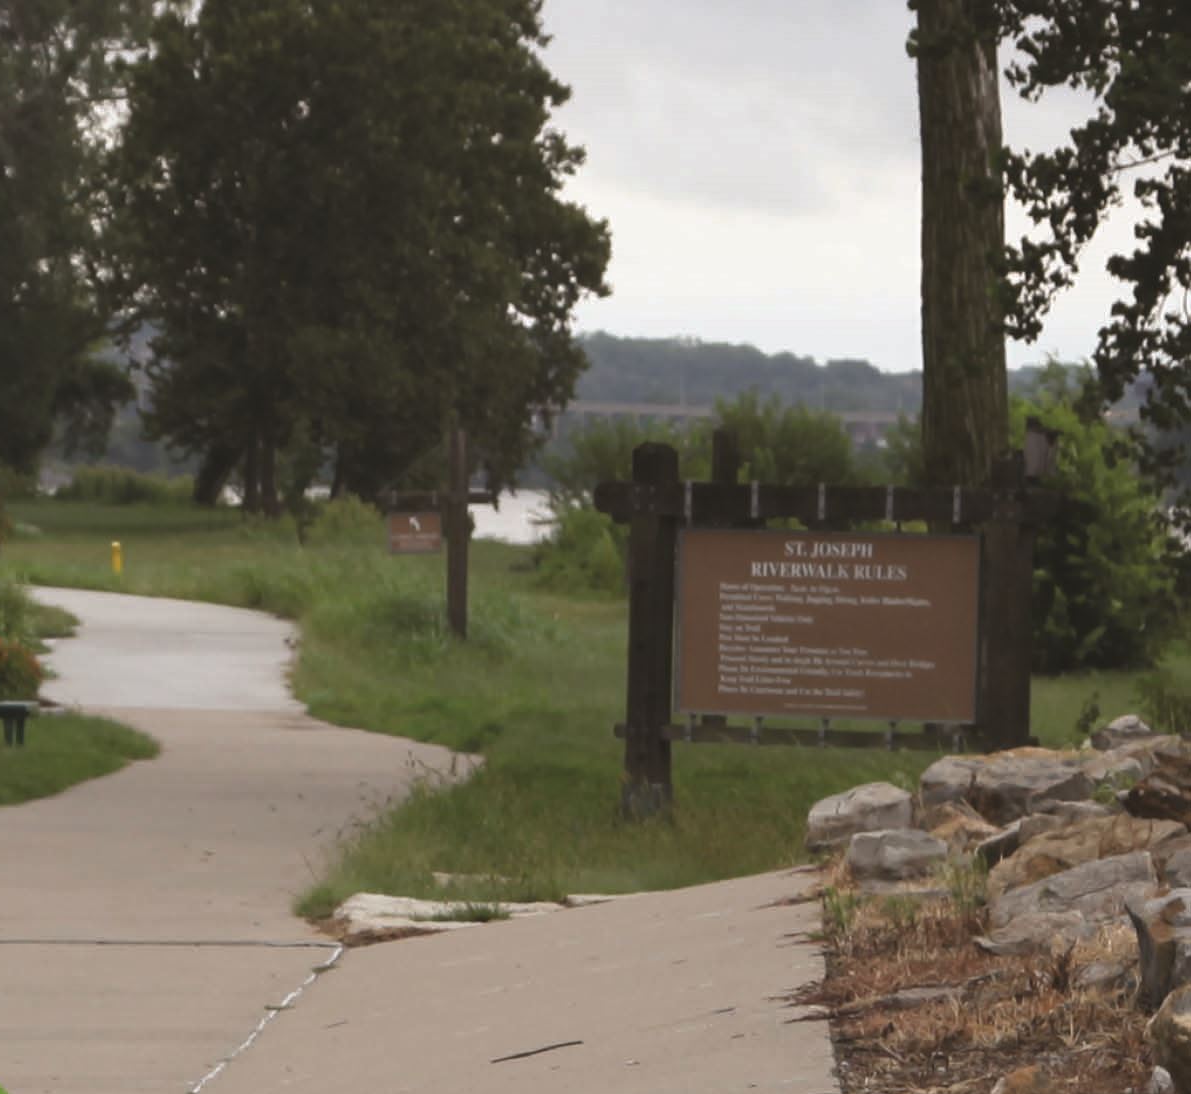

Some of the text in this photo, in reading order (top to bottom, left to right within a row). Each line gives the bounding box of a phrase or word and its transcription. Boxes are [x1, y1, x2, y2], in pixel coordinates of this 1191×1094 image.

[784, 541, 874, 558] ST. JOSEPH
[751, 561, 908, 581] RIVERWALK RULES
